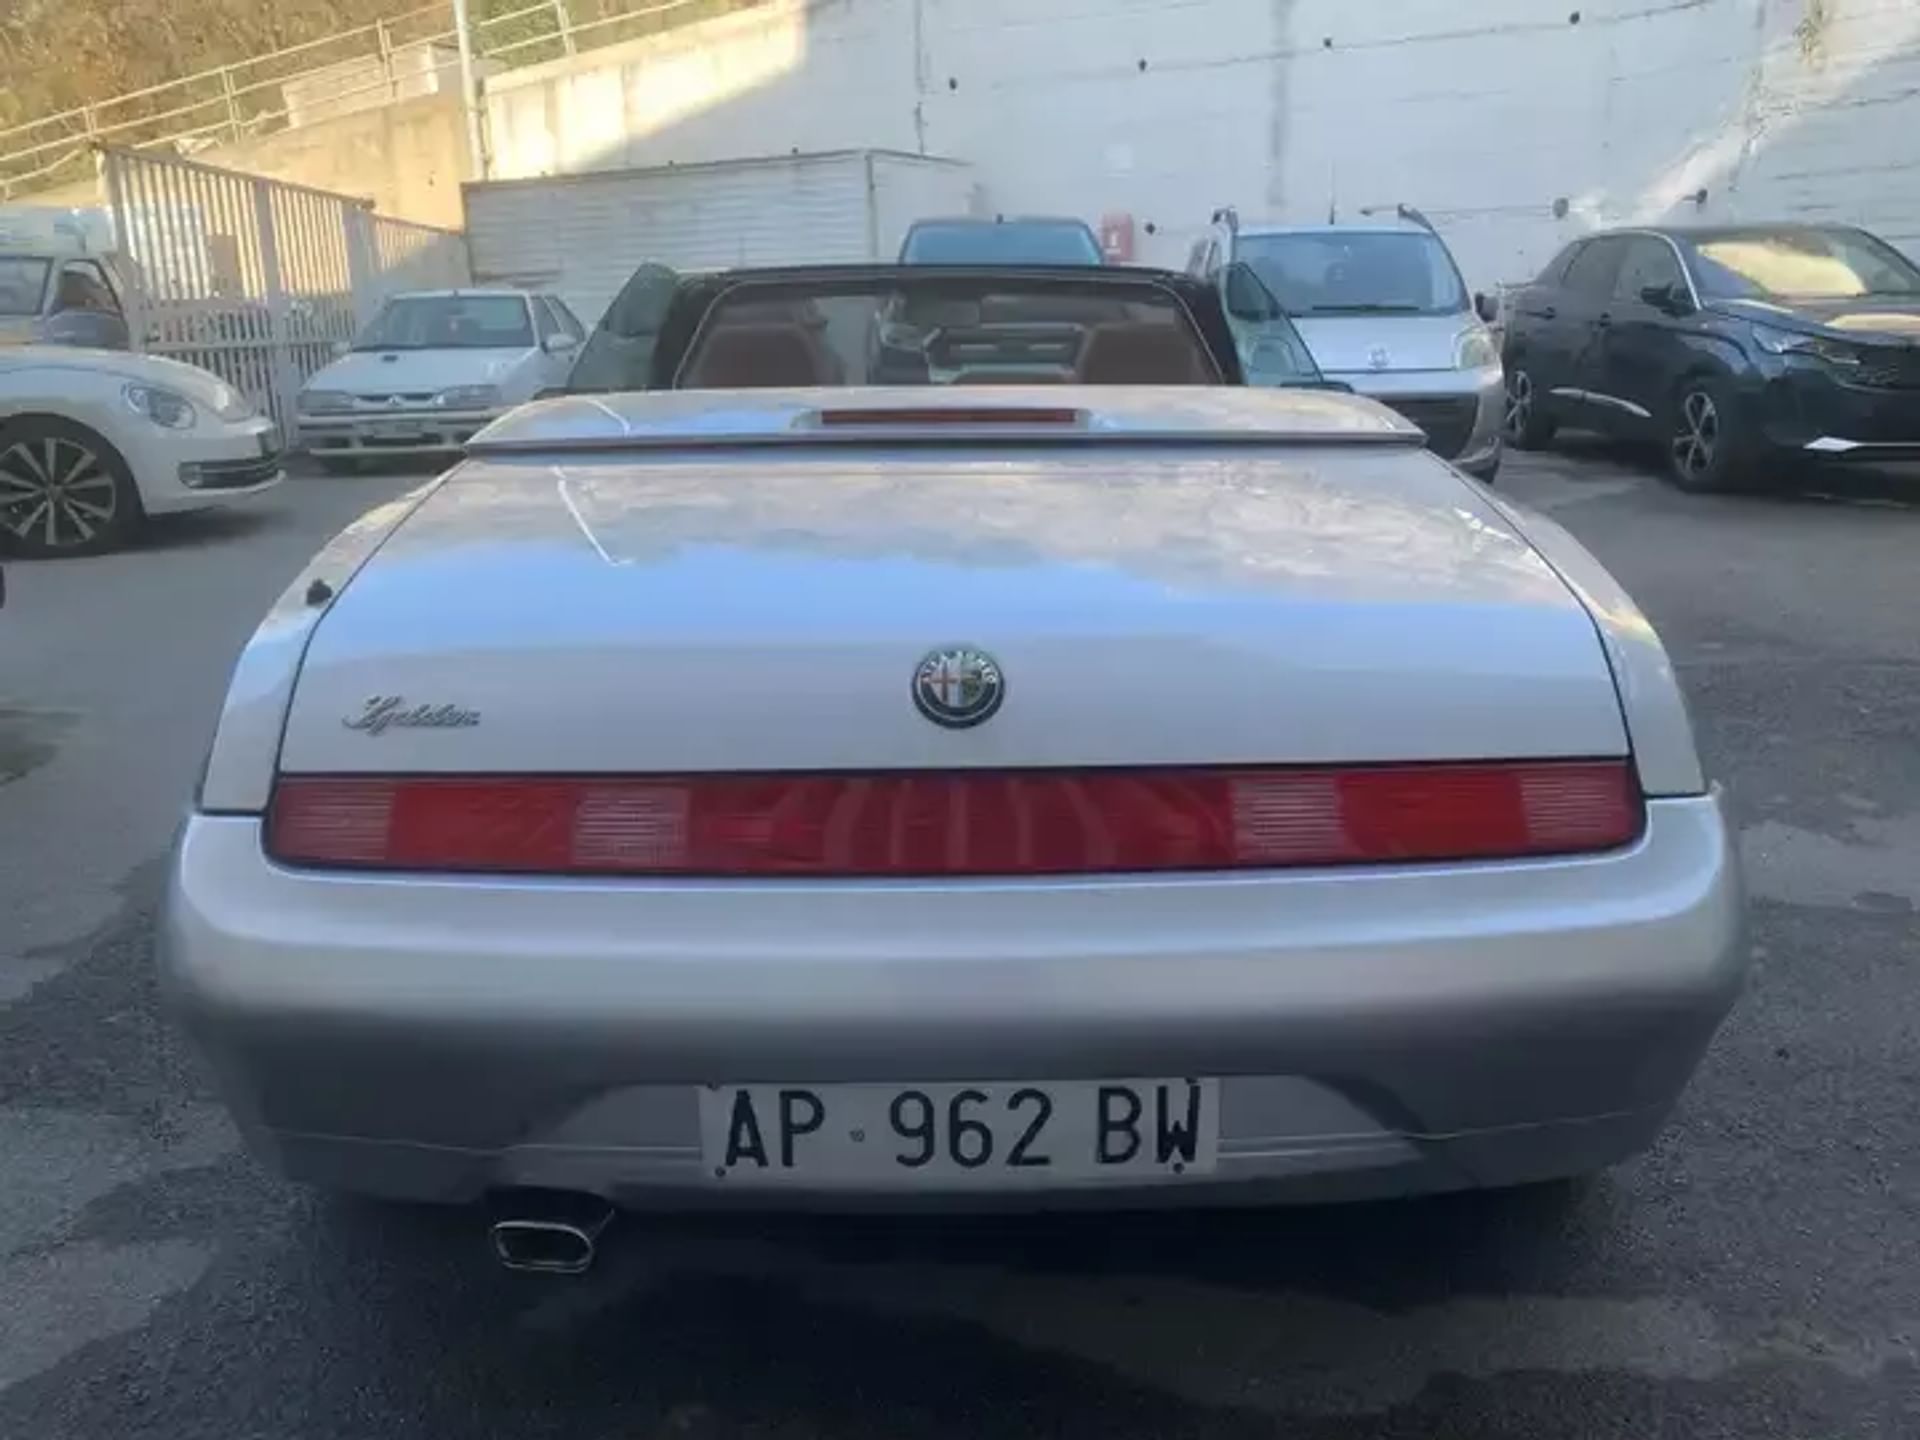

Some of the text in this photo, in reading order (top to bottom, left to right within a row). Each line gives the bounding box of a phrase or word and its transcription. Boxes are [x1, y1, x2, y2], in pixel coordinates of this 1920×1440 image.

[725, 1085, 1201, 1168] AP 962 BW
